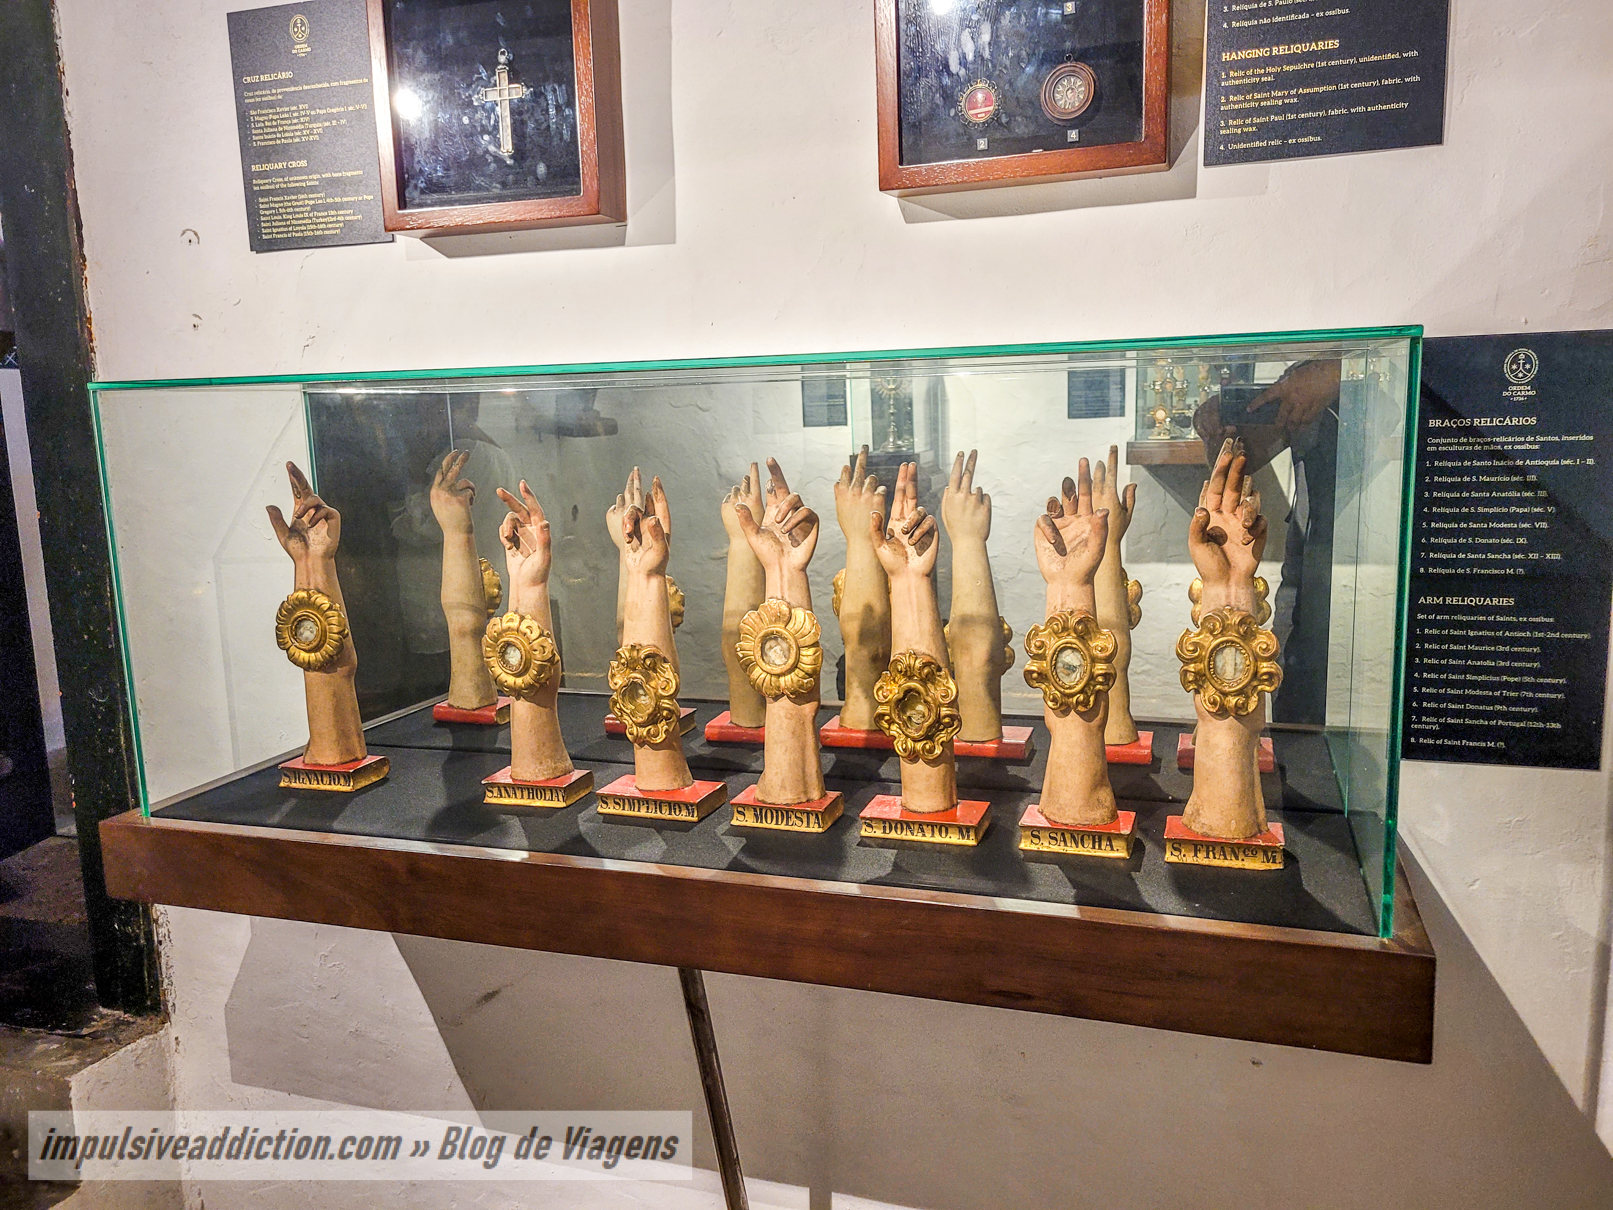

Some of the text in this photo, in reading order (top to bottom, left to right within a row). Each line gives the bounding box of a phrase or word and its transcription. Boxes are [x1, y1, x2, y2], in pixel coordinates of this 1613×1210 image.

[1232, 3, 1258, 12] Relíquia
[1232, 19, 1258, 28] Relíquia
[1272, 13, 1310, 22] identificada
[1222, 40, 1339, 61] HANGING RELIQUARIES
[1230, 70, 1245, 78] Relic
[1266, 65, 1282, 75] Holy
[1283, 63, 1314, 72] Sepulchre
[1316, 60, 1327, 69] (1st
[1402, 50, 1418, 58] with
[243, 71, 293, 83] CRUZ RELICÁRIO
[1221, 76, 1260, 86] authenticity
[1271, 89, 1289, 98] Mary
[1298, 85, 1337, 95] Assumption
[1338, 83, 1349, 91] (1st
[1220, 101, 1259, 110] authenticity
[1260, 98, 1283, 107] sealing
[1286, 112, 1297, 121] (1st
[1367, 102, 1409, 112] authenticity
[1220, 126, 1242, 135] sealing
[980, 140, 985, 148] 2
[1228, 140, 1267, 149] Unidentified
[251, 160, 307, 171] RELIQUARY CROSS
[1429, 416, 1537, 428] BRAÇOS RELICÁRIOS
[1446, 597, 1514, 606] RELIQUARIES
[736, 806, 822, 828] S. MODESTA
[864, 820, 876, 834] S.
[957, 827, 974, 841] M.
[1030, 830, 1044, 846] S.
[1170, 842, 1186, 858] S.
